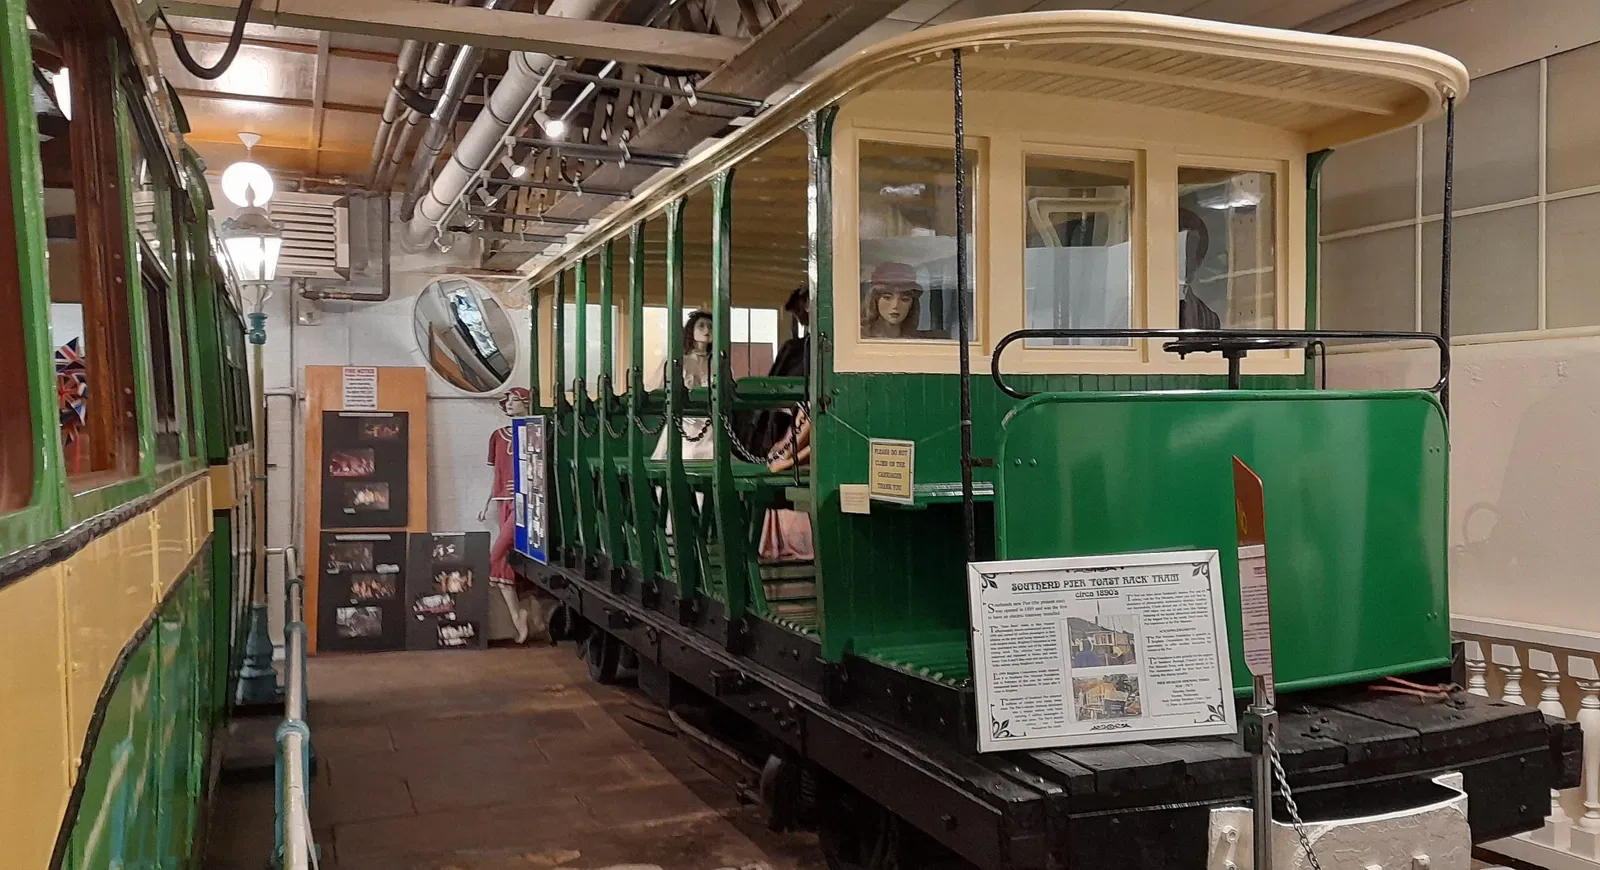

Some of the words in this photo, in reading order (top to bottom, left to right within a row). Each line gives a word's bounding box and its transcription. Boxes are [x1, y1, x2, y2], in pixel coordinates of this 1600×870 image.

[1012, 581, 1060, 592] SOUTHEND
[1063, 580, 1086, 588] PIER
[1152, 574, 1179, 582] TRAM
